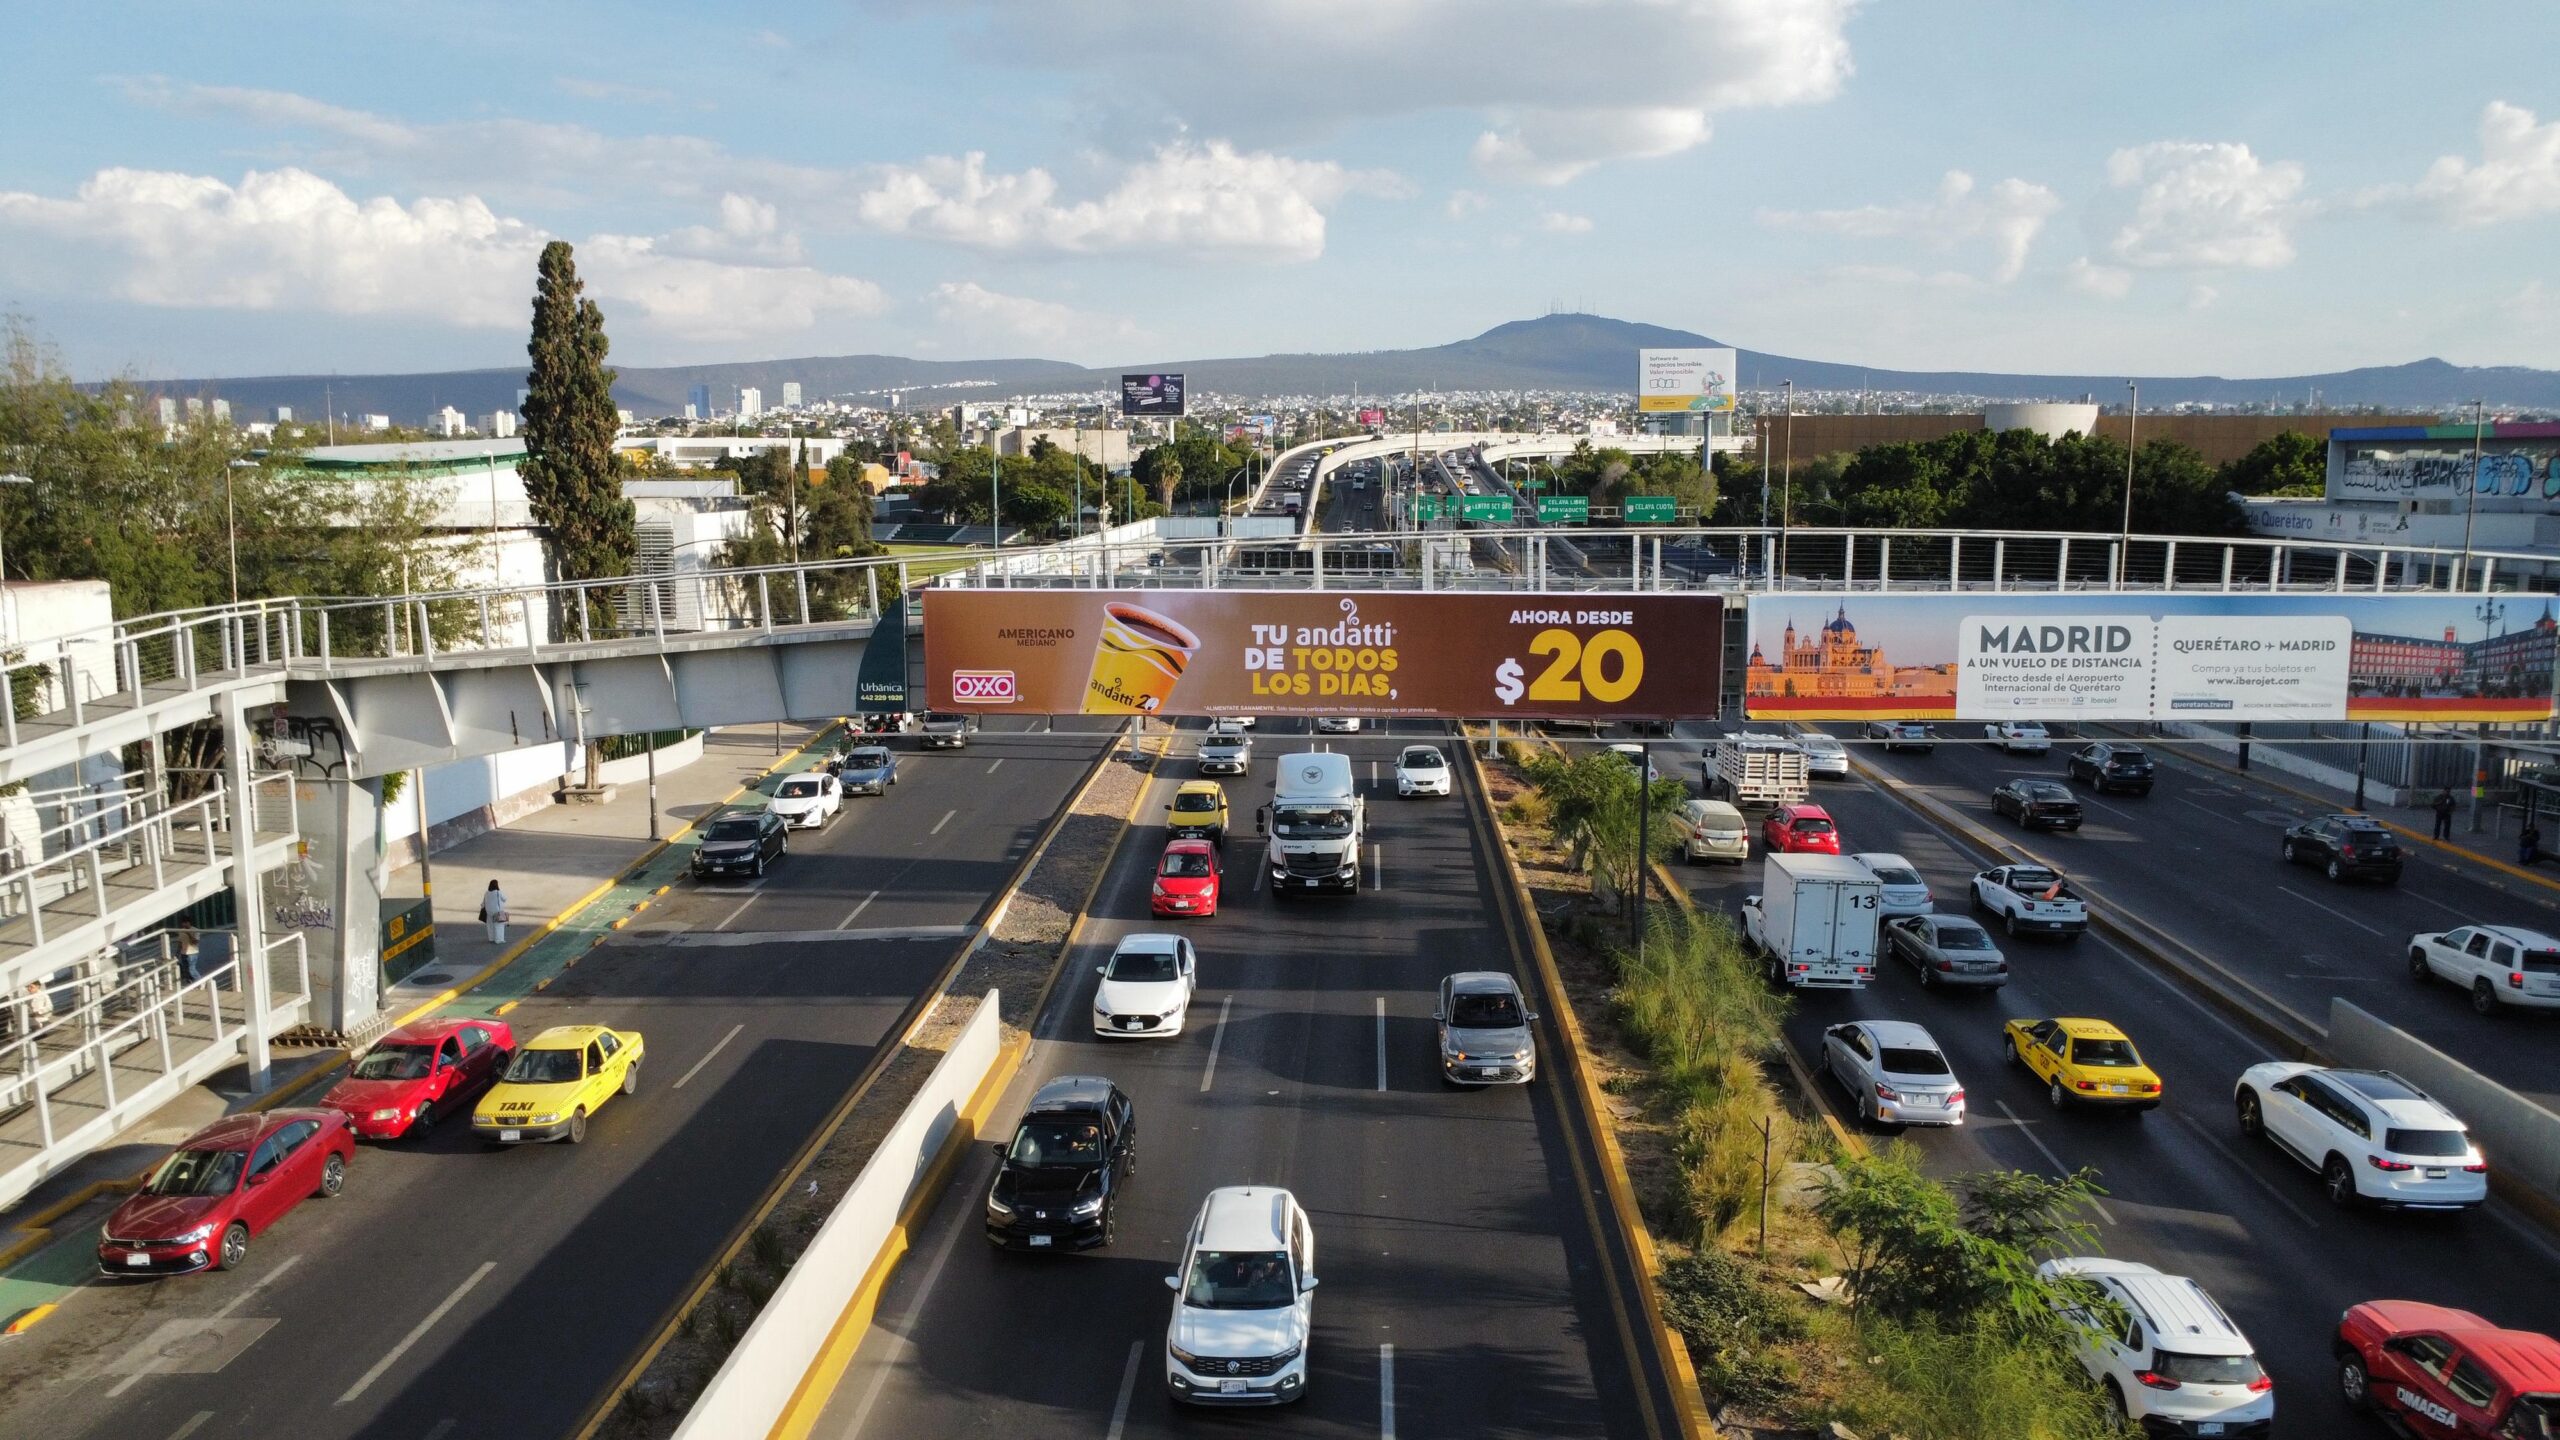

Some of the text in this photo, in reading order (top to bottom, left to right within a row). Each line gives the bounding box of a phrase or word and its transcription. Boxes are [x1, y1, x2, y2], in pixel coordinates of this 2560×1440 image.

[2261, 510, 2313, 530] Querétaro
[1509, 610, 1633, 625] AHORA DESDE
[998, 629, 1075, 639] AMERICANO
[1252, 621, 1392, 646] TU andatti
[1980, 625, 2132, 653] MADRID
[2173, 636, 2336, 654] QUERÉTARO MADRID
[1245, 648, 1398, 672] DE TODOS
[1495, 629, 1644, 706] $20
[1967, 658, 2142, 668] A UN VUELO DE DISTANCIA
[2192, 664, 2230, 675] Compra
[2233, 666, 2244, 675] ya
[2247, 665, 2262, 673] tus
[2265, 664, 2301, 673] boletos
[956, 676, 1012, 697] OXXO
[1253, 672, 1310, 695] LOS
[1982, 673, 2125, 684] Directo desde el Aeropuerto
[2207, 676, 2300, 687] www.iberojet.com
[1091, 679, 1135, 706] andatti
[1984, 683, 2121, 693] Internacional de Querétaro
[1850, 895, 1876, 909] 13
[499, 1101, 536, 1111] TAXI
